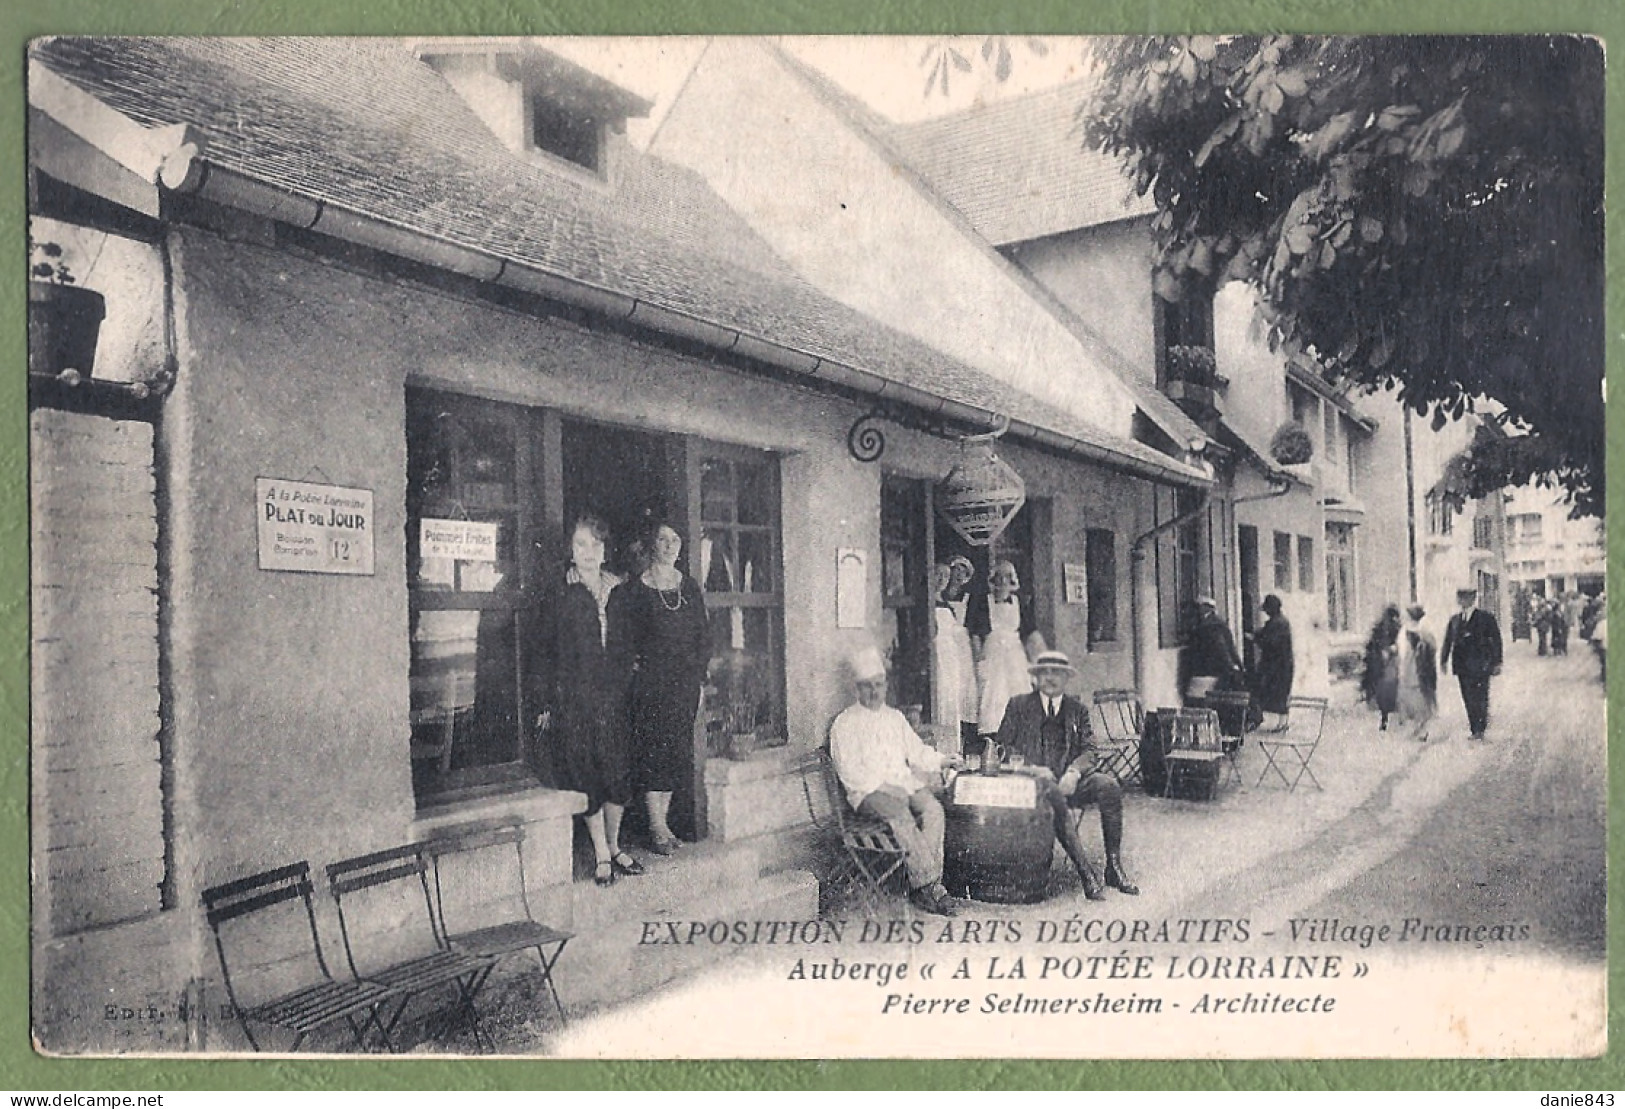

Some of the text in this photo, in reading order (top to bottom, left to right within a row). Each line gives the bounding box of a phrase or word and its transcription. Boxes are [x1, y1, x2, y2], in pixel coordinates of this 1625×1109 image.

[265, 486, 276, 500] A
[265, 502, 305, 524] PLAT
[327, 508, 365, 530] JOUR
[334, 540, 350, 561] 12
